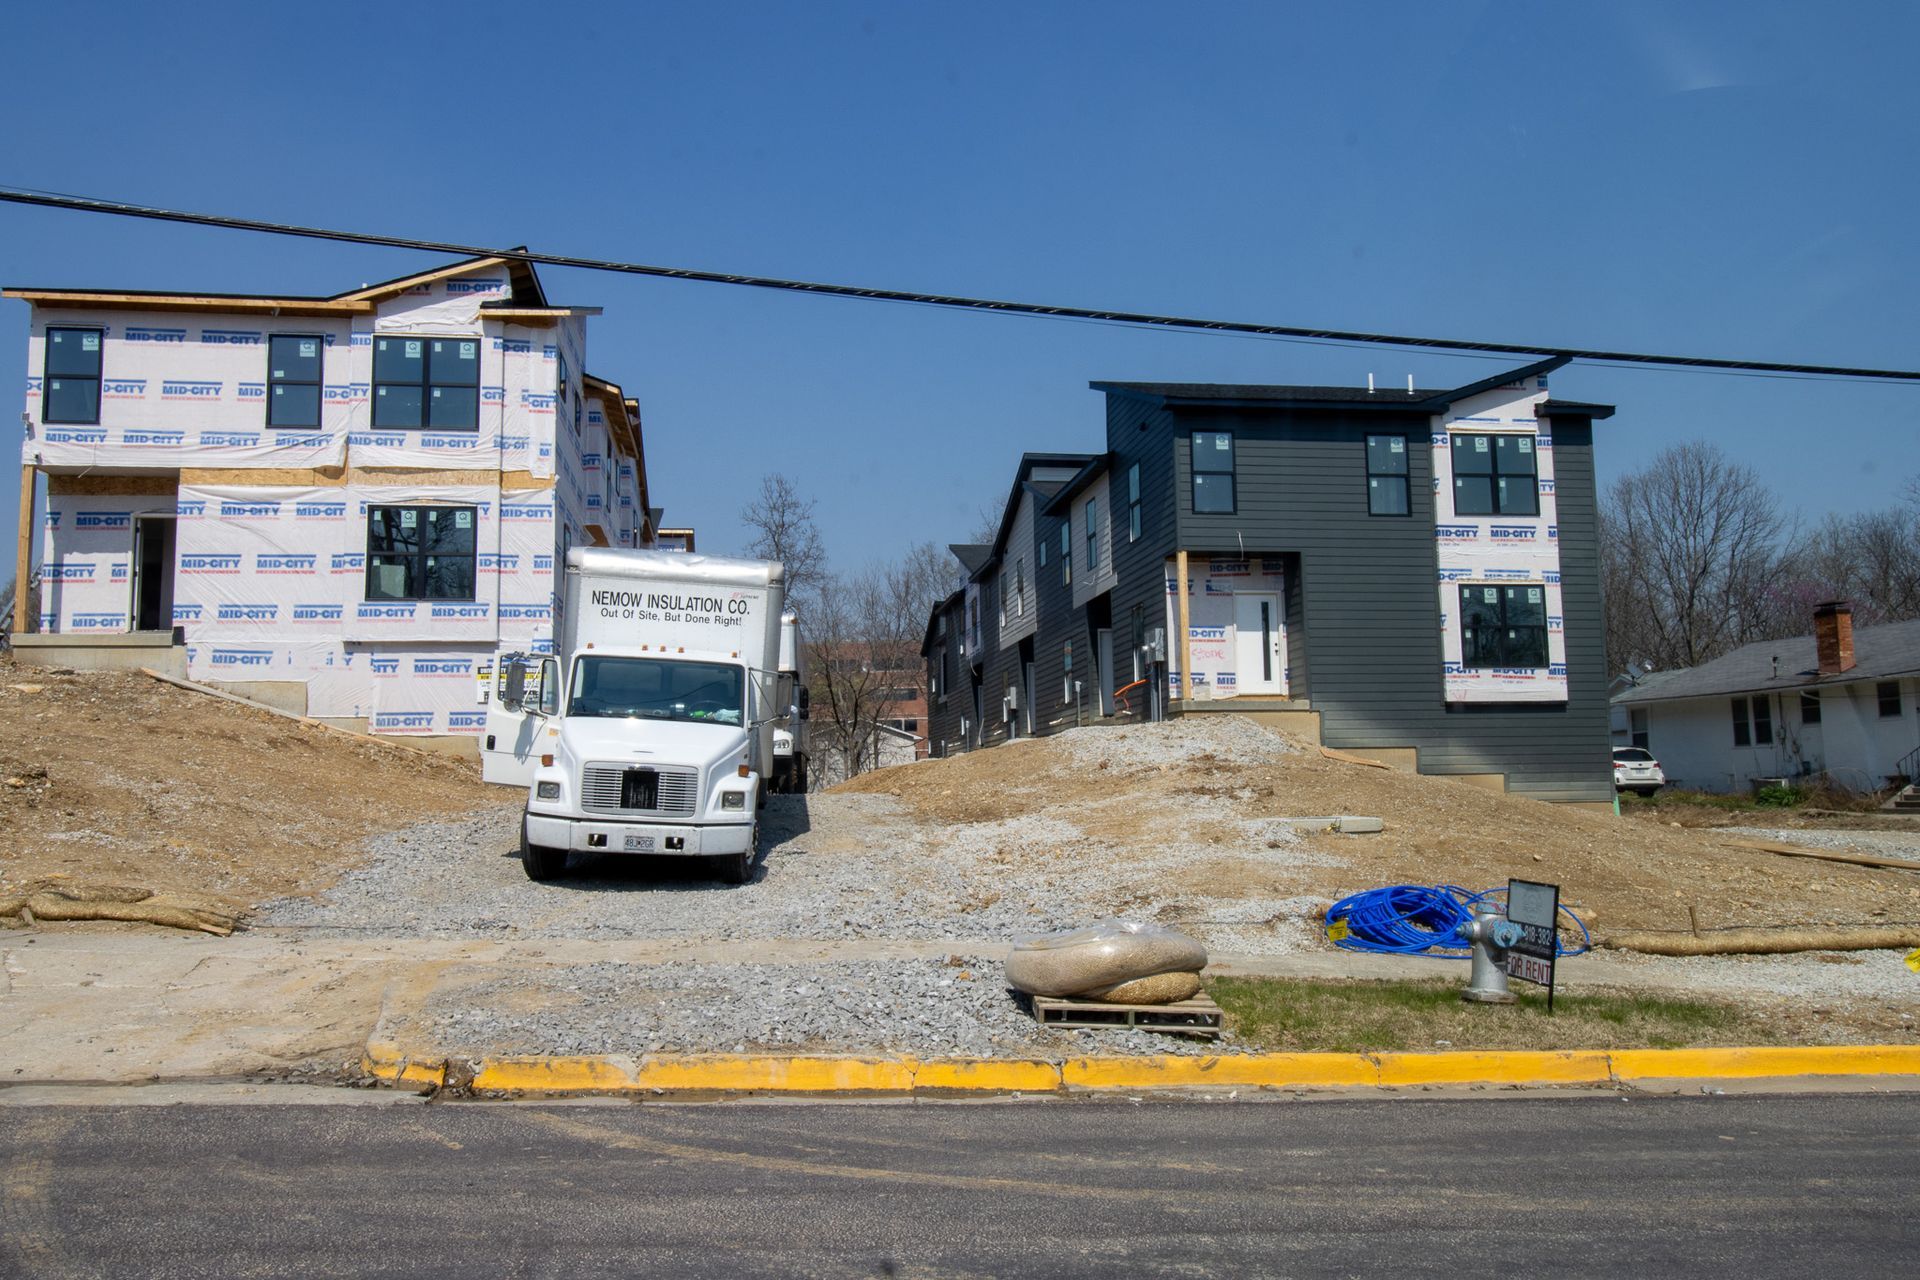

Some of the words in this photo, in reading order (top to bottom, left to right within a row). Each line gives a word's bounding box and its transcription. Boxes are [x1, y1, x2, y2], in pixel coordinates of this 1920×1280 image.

[447, 283, 502, 292] MID-CITY
[126, 332, 186, 342] MID-CITY
[202, 334, 261, 344] MID-CITY
[162, 385, 222, 395] MID-CITY
[46, 433, 107, 443] MID-CITY
[124, 434, 184, 444] MID-CITY
[200, 436, 260, 446] MID-CITY
[421, 438, 478, 448] MID-CITY
[222, 506, 281, 515] MID-CITY
[1491, 530, 1536, 538] MID-CITY
[182, 558, 241, 568] MID-CITY
[257, 558, 316, 569] MID-CITY
[592, 591, 642, 607] NEMOW
[648, 594, 722, 613] INSULATION
[728, 599, 750, 614] CO.
[219, 610, 277, 619] MID-CITY
[358, 608, 415, 617] MID-CITY
[432, 608, 489, 617] MID-CITY
[601, 608, 618, 617] Out
[623, 609, 634, 618] Of
[639, 610, 659, 621] Site,
[665, 613, 680, 622] But
[685, 614, 710, 623] Done
[715, 616, 742, 626] Right!
[212, 655, 273, 664] MID-CITY
[414, 664, 472, 673] MID-CITY
[376, 717, 433, 726] MID-CITY
[1526, 960, 1551, 982] RENT
